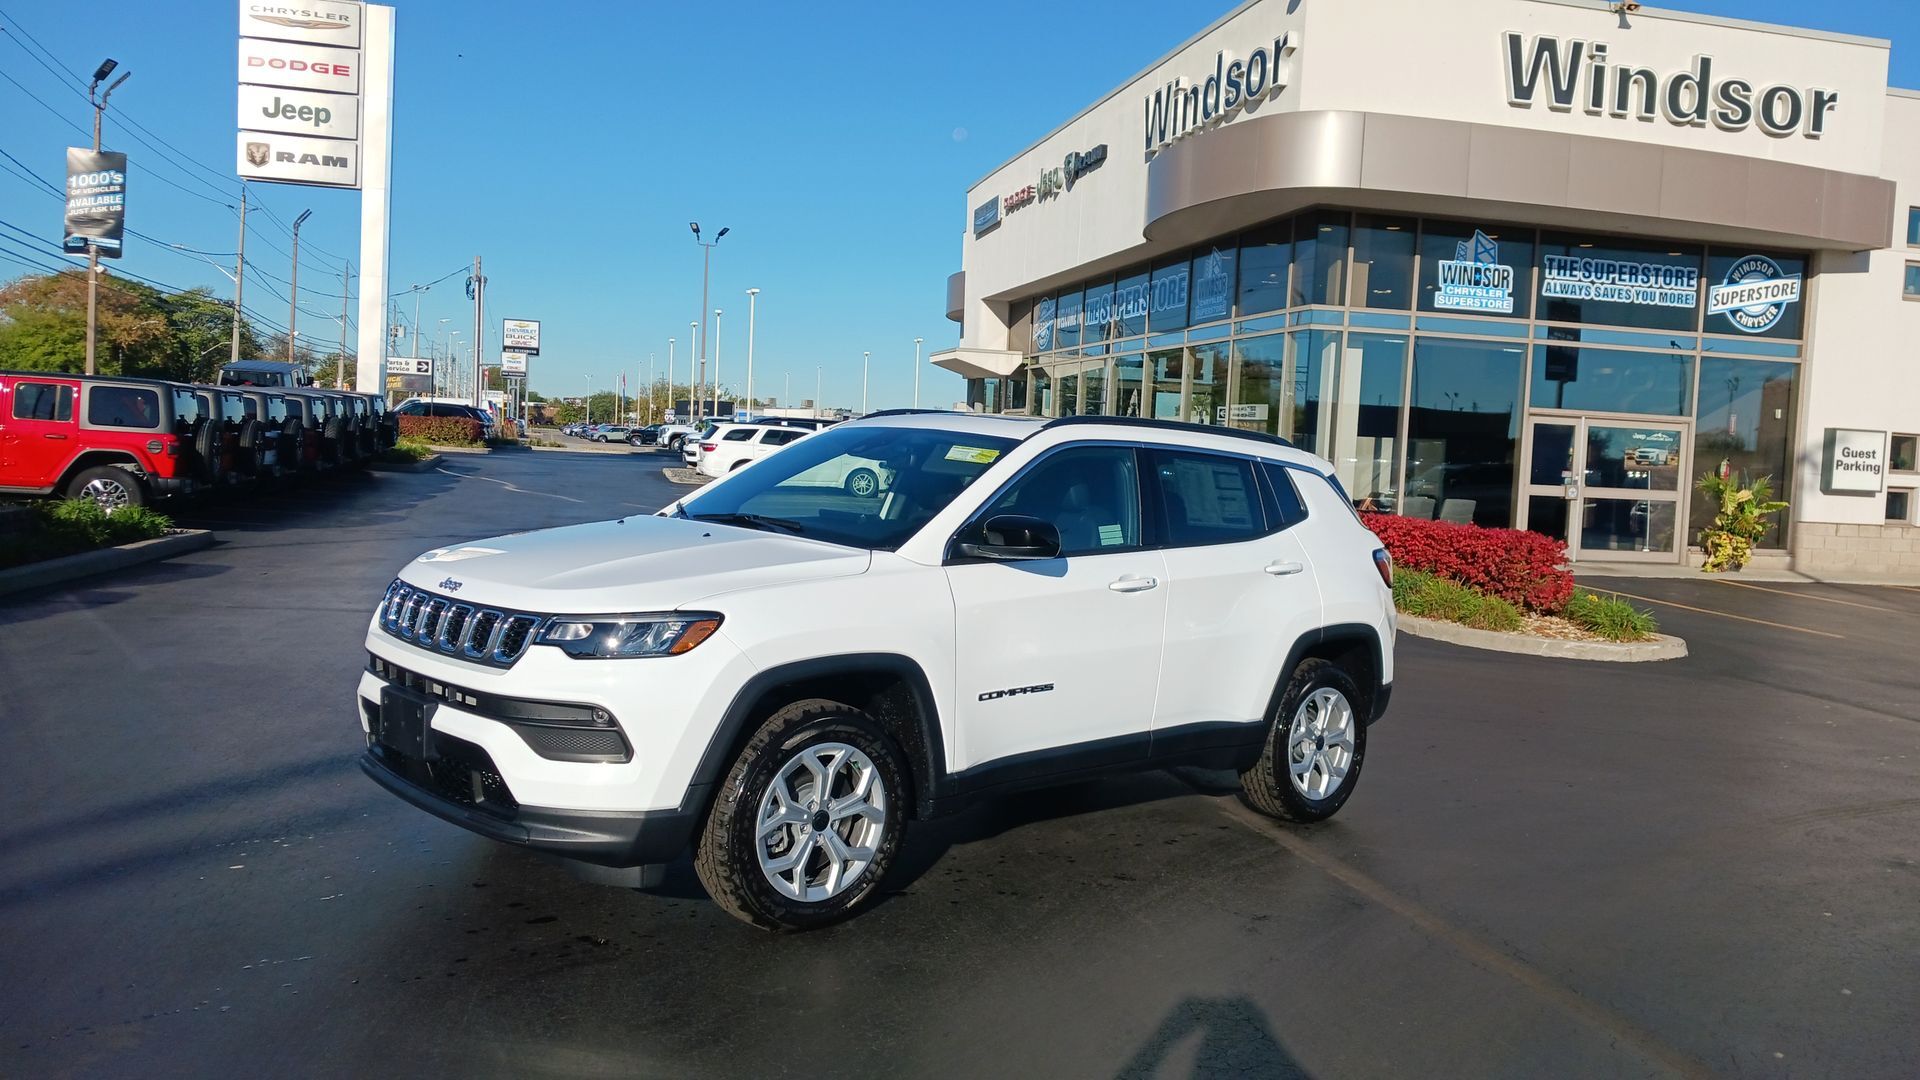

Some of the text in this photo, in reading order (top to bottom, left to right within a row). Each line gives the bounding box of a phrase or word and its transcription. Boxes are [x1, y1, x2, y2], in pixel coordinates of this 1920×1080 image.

[250, 5, 350, 22] CHRYSLER
[247, 56, 350, 77] DODGE
[1145, 31, 1296, 154] Windsor
[1502, 30, 1839, 138] Windsor
[262, 96, 331, 127] Jeep
[276, 151, 348, 168] RAM
[69, 171, 124, 188] 1000's
[71, 185, 120, 196] OF VEHICLES
[68, 204, 122, 216] JUST ASK US
[69, 194, 123, 208] AVAILABLE
[1441, 263, 1511, 290] WINDSOR
[1545, 256, 1696, 288] THE SUPERSTORE
[1731, 260, 1774, 281] WINDSOR
[1101, 273, 1187, 323] SUPERSTORE
[1446, 286, 1503, 298] CHRYSLER
[1544, 281, 1695, 306] ALWAYS SAVES YOU MORE!
[1713, 282, 1796, 307] SUPERSTORE
[1438, 295, 1511, 310] SUPERSTORE
[1736, 305, 1779, 328] CHRYSLER
[505, 333, 537, 341] BUICK
[1841, 446, 1877, 459] Guest
[1835, 459, 1881, 475] Parking
[978, 683, 1055, 701] COMPASS
